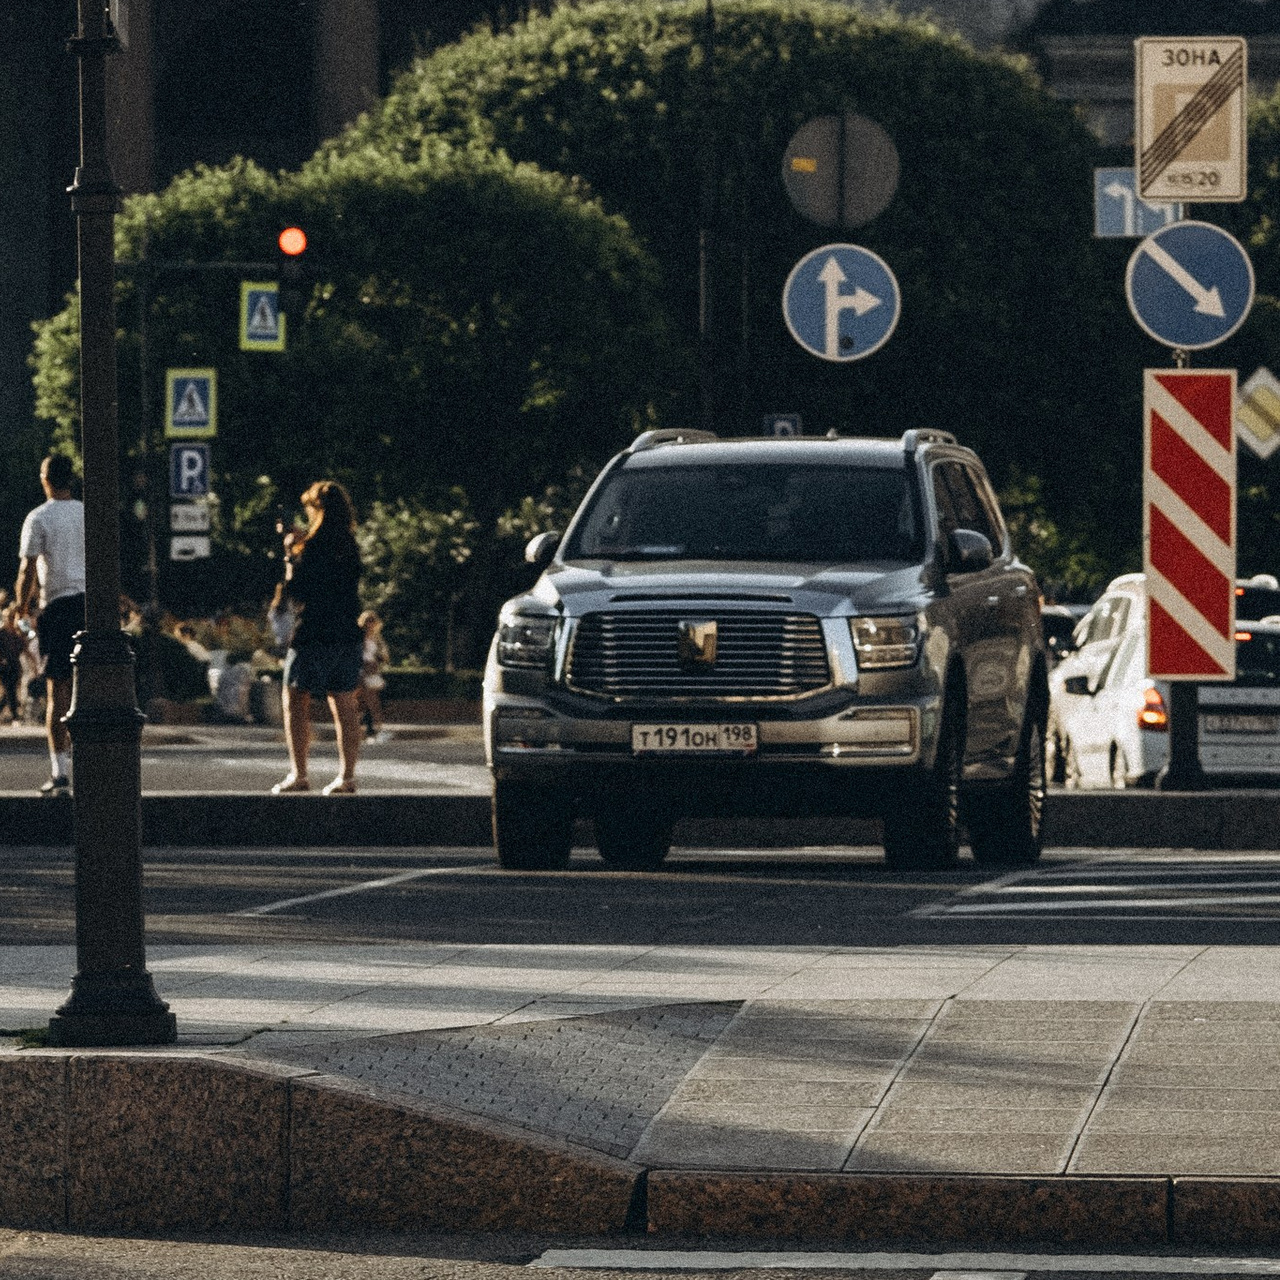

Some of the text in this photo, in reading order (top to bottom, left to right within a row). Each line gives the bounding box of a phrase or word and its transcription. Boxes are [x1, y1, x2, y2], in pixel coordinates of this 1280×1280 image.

[1161, 48, 1221, 67] ЗОНА
[181, 449, 204, 491] P
[722, 725, 753, 742] 198
